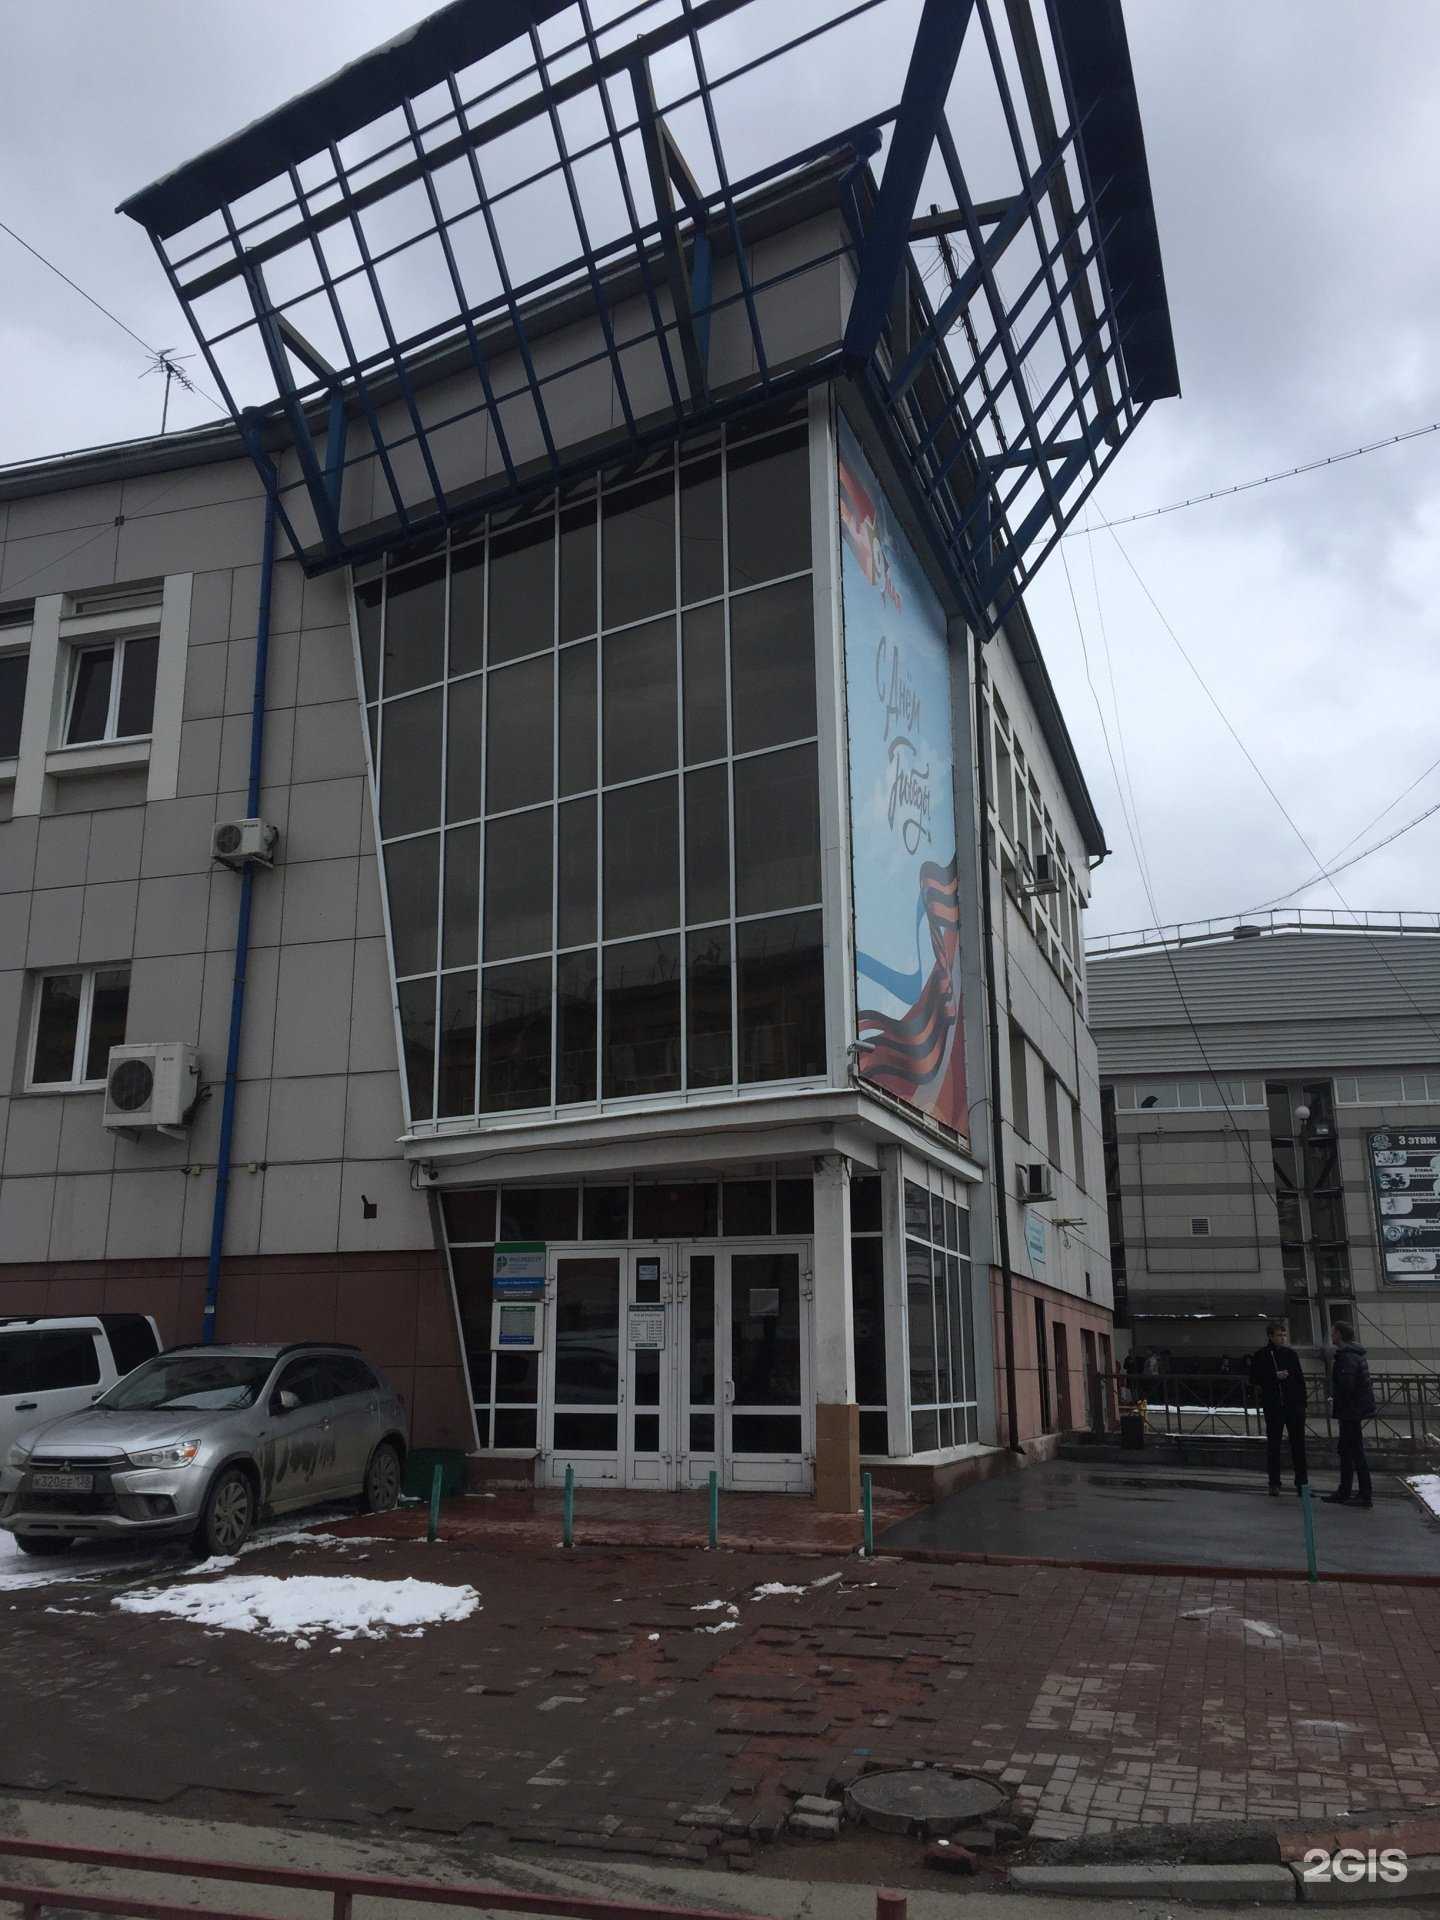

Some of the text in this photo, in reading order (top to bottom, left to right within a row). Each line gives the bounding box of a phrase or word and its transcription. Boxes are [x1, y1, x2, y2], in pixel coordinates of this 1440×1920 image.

[876, 636, 887, 703] С
[1398, 1135, 1437, 1145] 3 этаж
